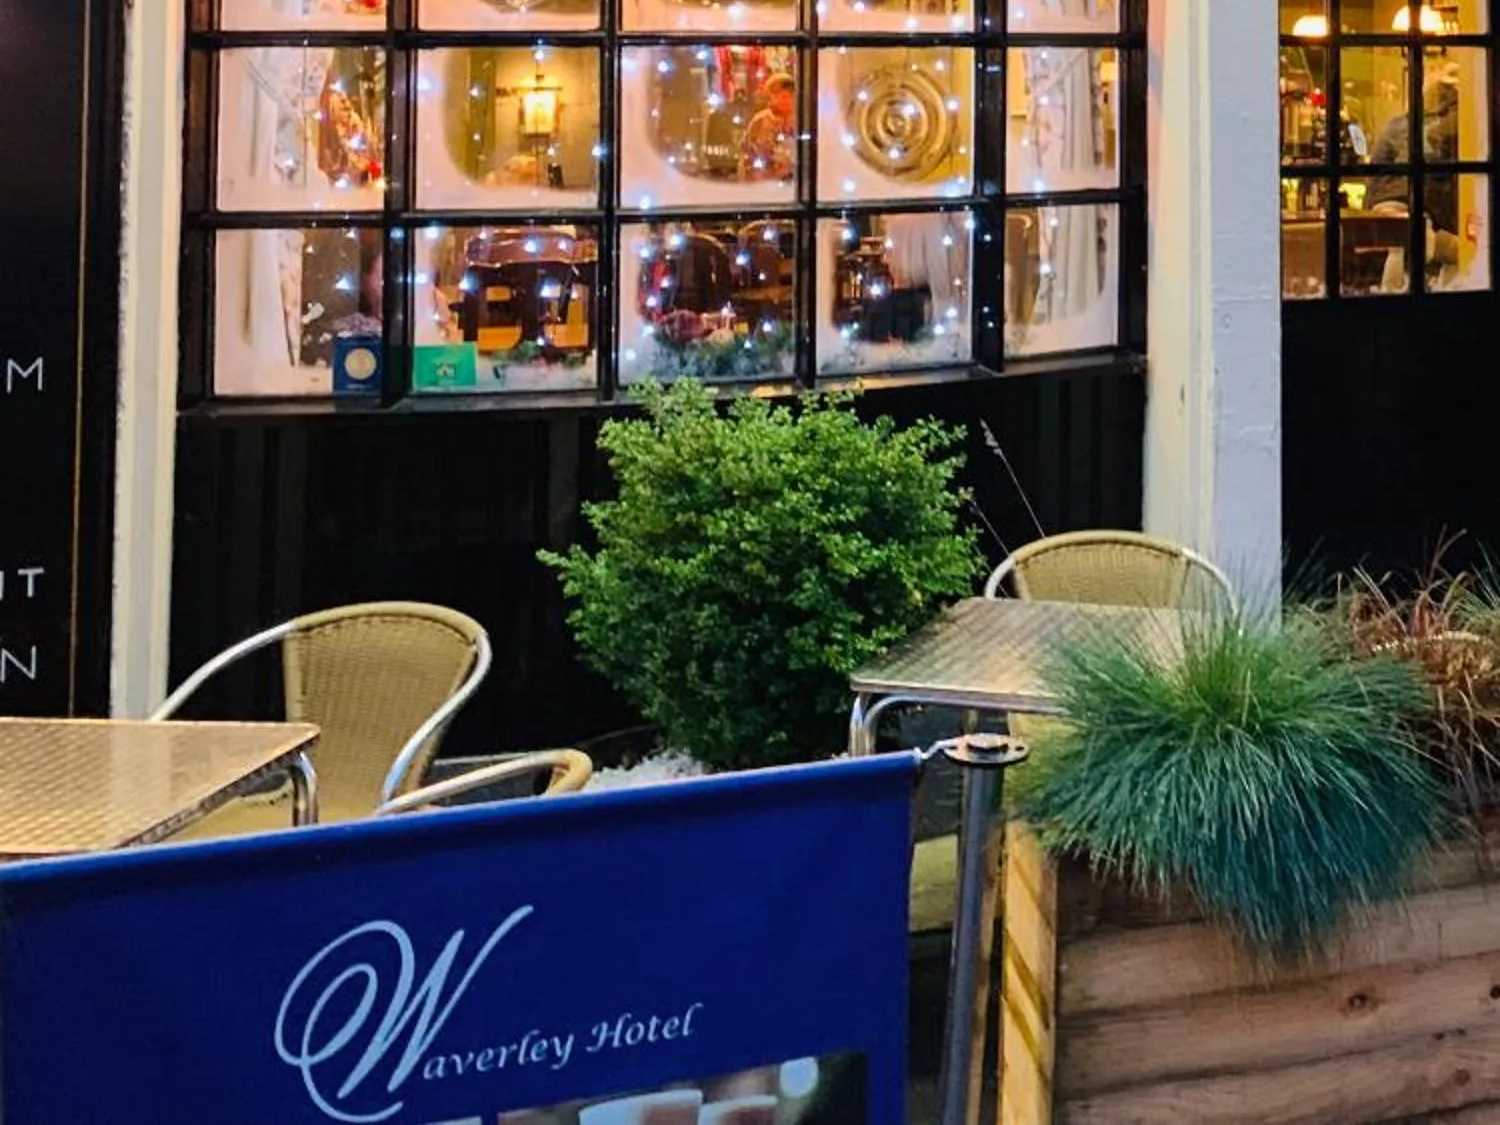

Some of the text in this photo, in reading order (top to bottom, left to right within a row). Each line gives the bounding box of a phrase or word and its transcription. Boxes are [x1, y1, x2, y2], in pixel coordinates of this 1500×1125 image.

[7, 357, 43, 394] M
[274, 905, 705, 1123] Waverley Hotel
